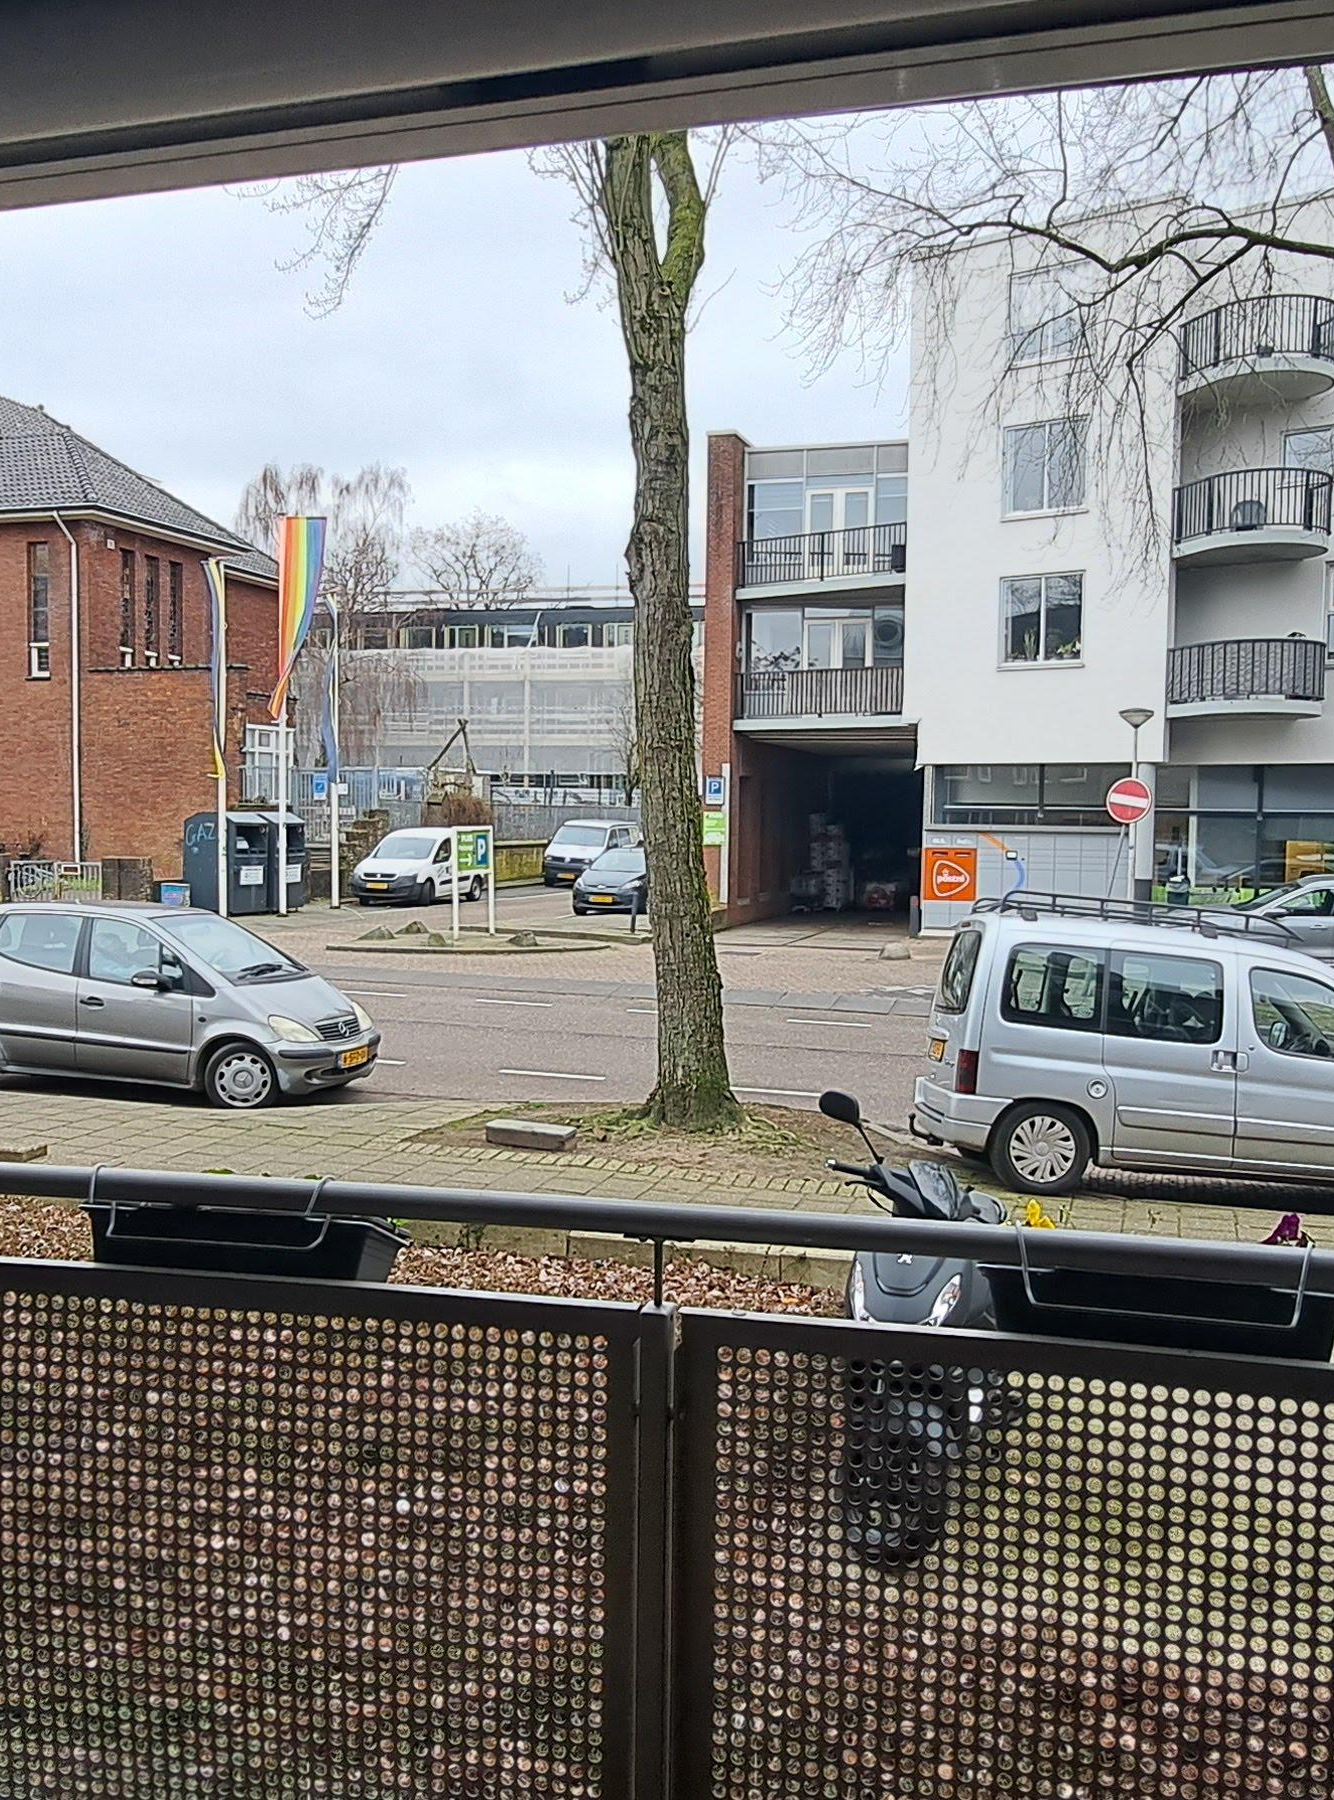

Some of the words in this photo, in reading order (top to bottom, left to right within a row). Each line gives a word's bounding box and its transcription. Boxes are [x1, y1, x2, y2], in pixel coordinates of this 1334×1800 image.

[711, 782, 719, 793] P
[186, 822, 216, 846] GAZ
[477, 838, 486, 861] P
